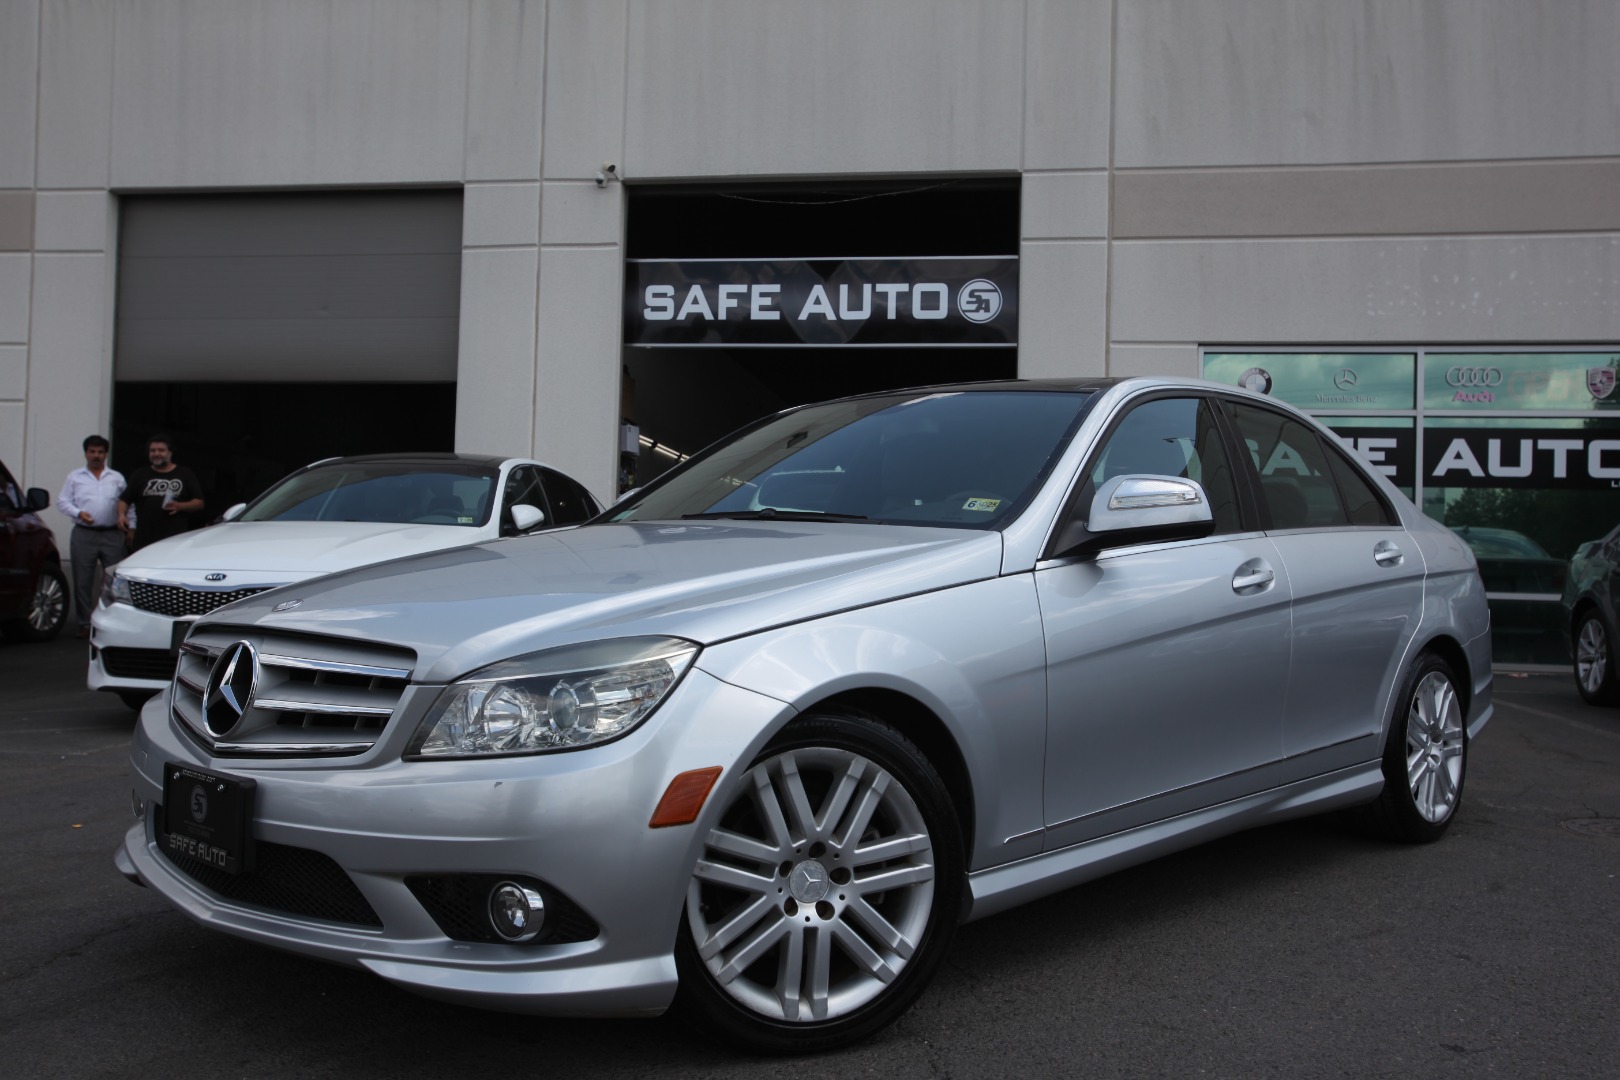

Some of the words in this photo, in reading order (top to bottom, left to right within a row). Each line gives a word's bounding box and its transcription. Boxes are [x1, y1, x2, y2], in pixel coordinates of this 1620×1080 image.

[643, 284, 780, 320] SAFE
[798, 283, 948, 320] AUTO
[1452, 390, 1496, 403] Audi
[1507, 368, 1584, 401] OPEN
[1432, 438, 1620, 479] AUTO
[169, 833, 197, 856] SAFE
[198, 843, 227, 867] AUTO
